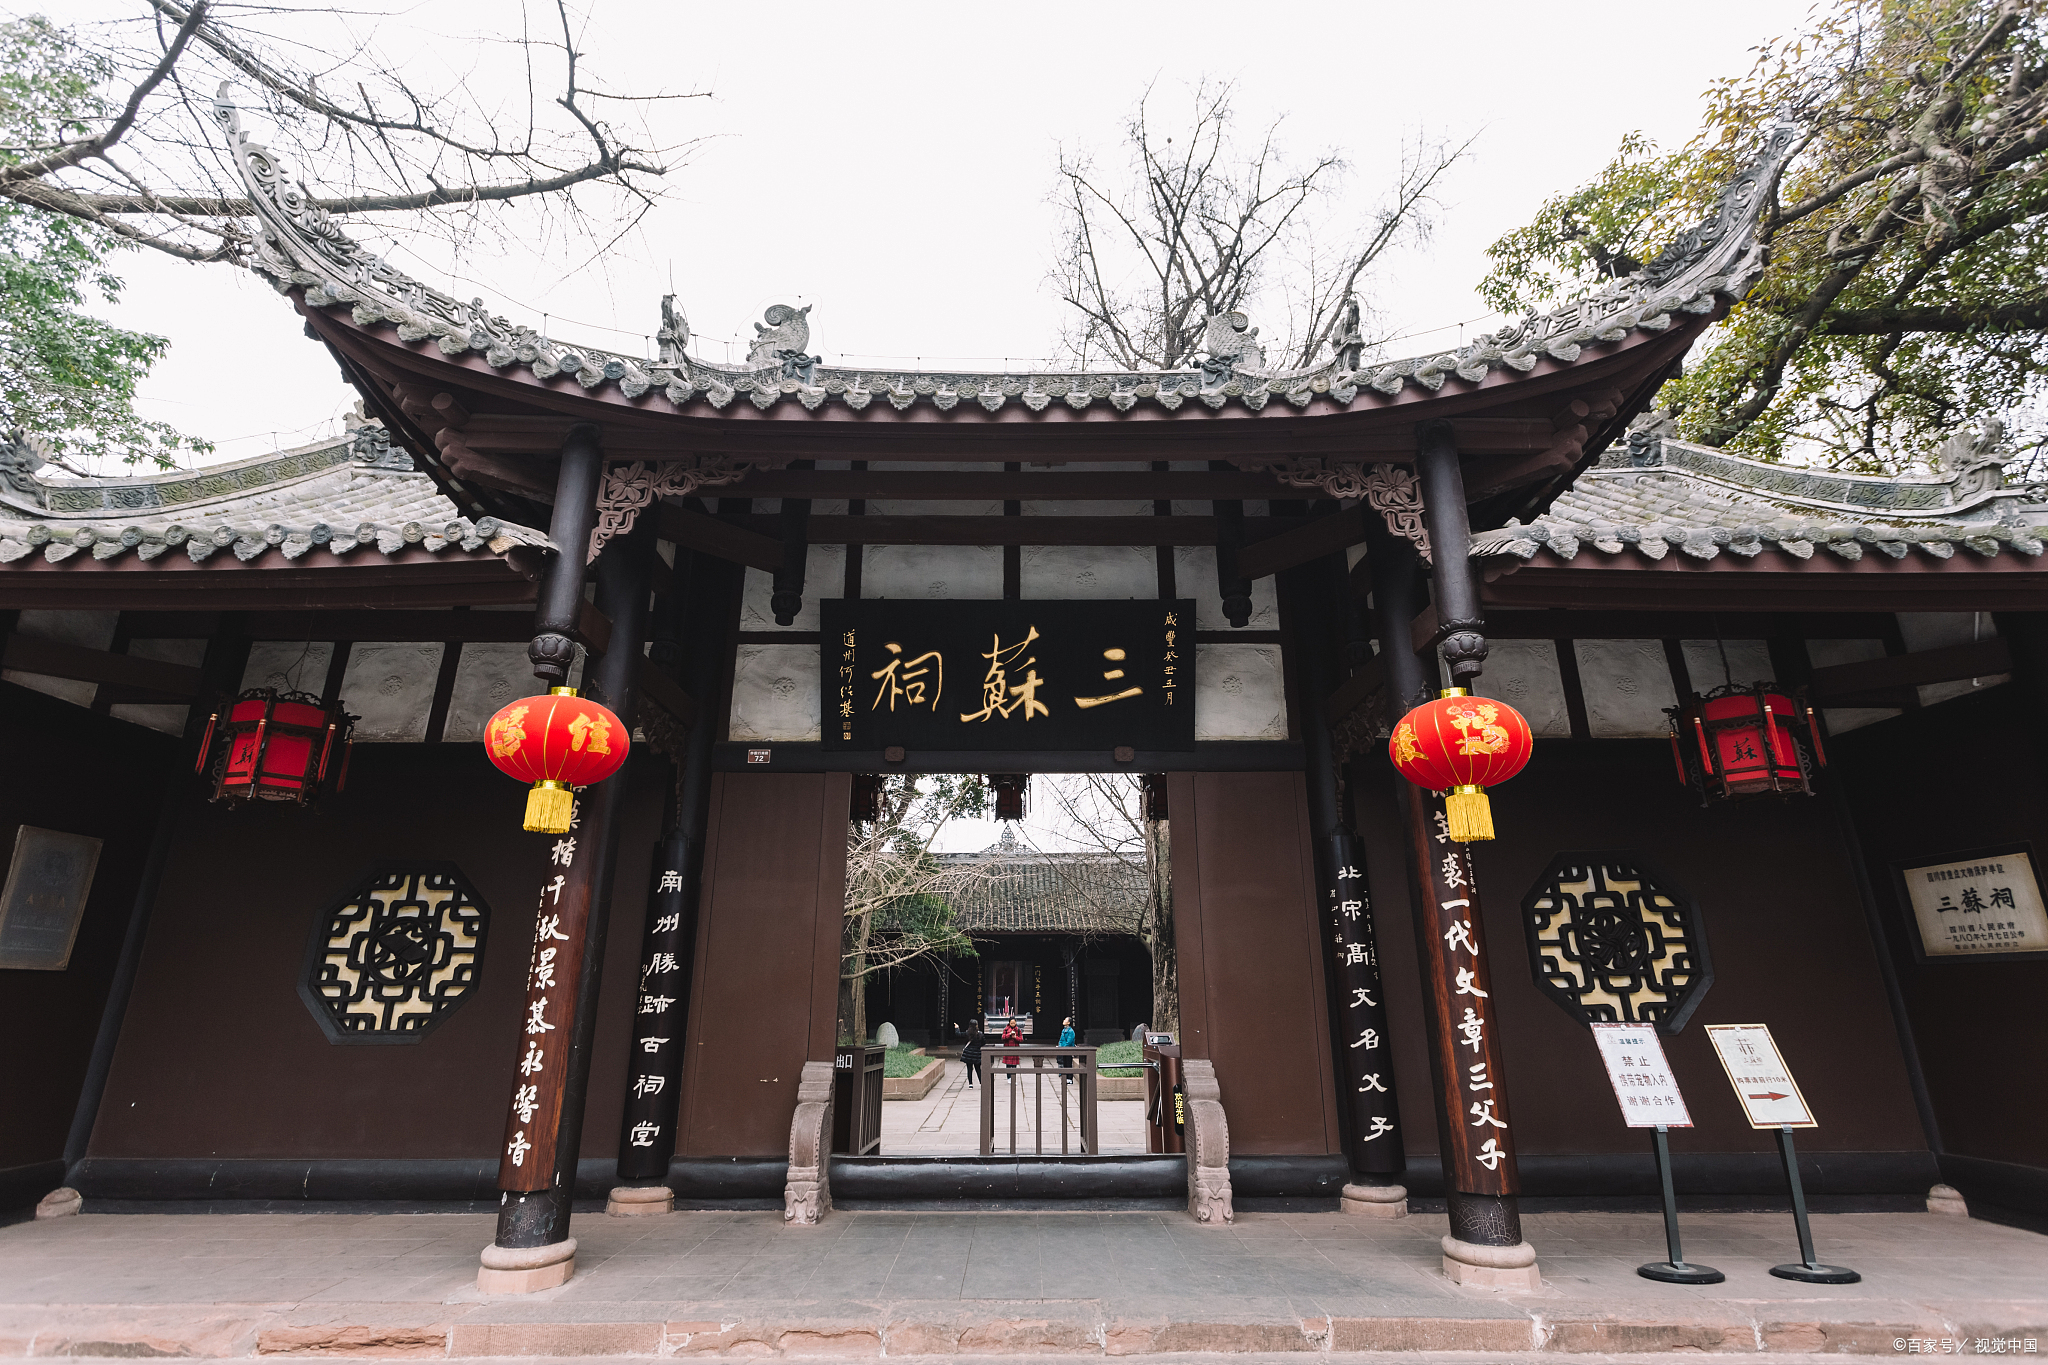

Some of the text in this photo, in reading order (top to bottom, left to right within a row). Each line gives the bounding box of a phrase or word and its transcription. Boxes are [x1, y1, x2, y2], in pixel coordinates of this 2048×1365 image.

[568, 712, 612, 756] 佳
[836, 1053, 853, 1069] 出口
[1621, 1055, 1651, 1067] 禁止
[1618, 1072, 1668, 1087] 携带宠物入内
[1627, 1095, 1675, 1106] 谢谢合作
[1174, 1092, 1185, 1125] 欢迎光临
